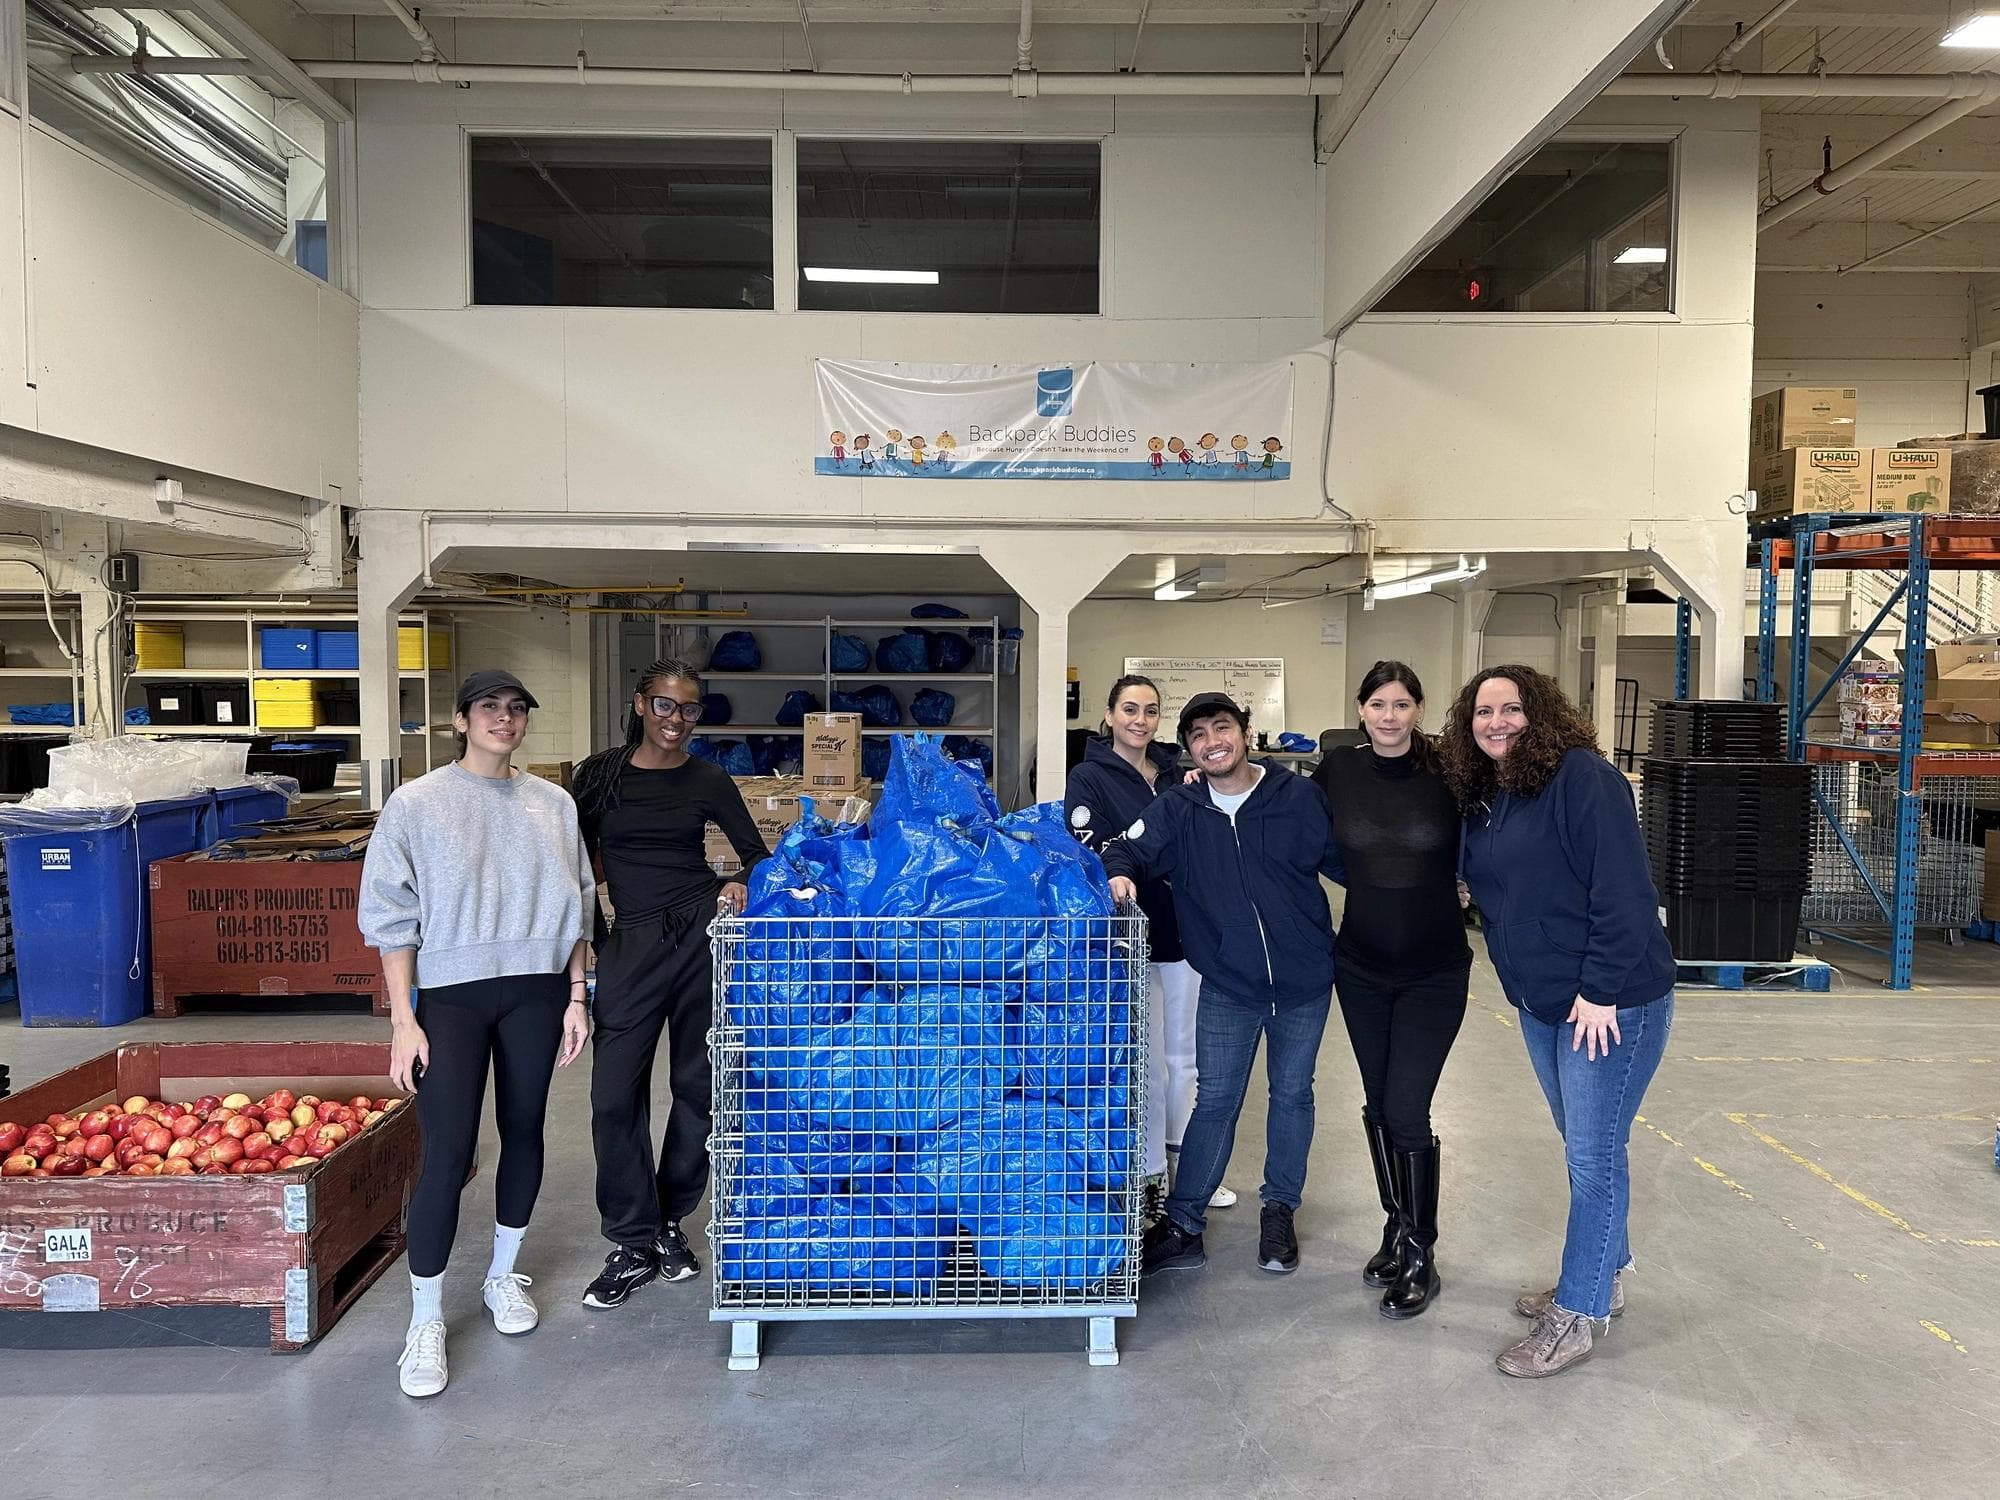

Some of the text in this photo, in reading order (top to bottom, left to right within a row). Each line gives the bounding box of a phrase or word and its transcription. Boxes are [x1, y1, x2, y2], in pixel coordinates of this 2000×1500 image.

[969, 425, 1137, 444] Backpack Buddies
[1813, 452, 1857, 462] U-HAUL
[1892, 453, 1936, 463] U-HAUL
[1876, 473, 1916, 481] MEDIUM BOX
[815, 735, 840, 744] Kellogg's
[834, 739, 848, 752] K
[777, 822, 790, 835] K
[42, 853, 70, 861] URBAN
[187, 887, 356, 912] RALPH'S PRODUCE LTD
[216, 914, 329, 938] 604-818-5753
[217, 940, 330, 964] 604-813-5651
[48, 1234, 88, 1252] GALA
[70, 1251, 89, 1260] 113
